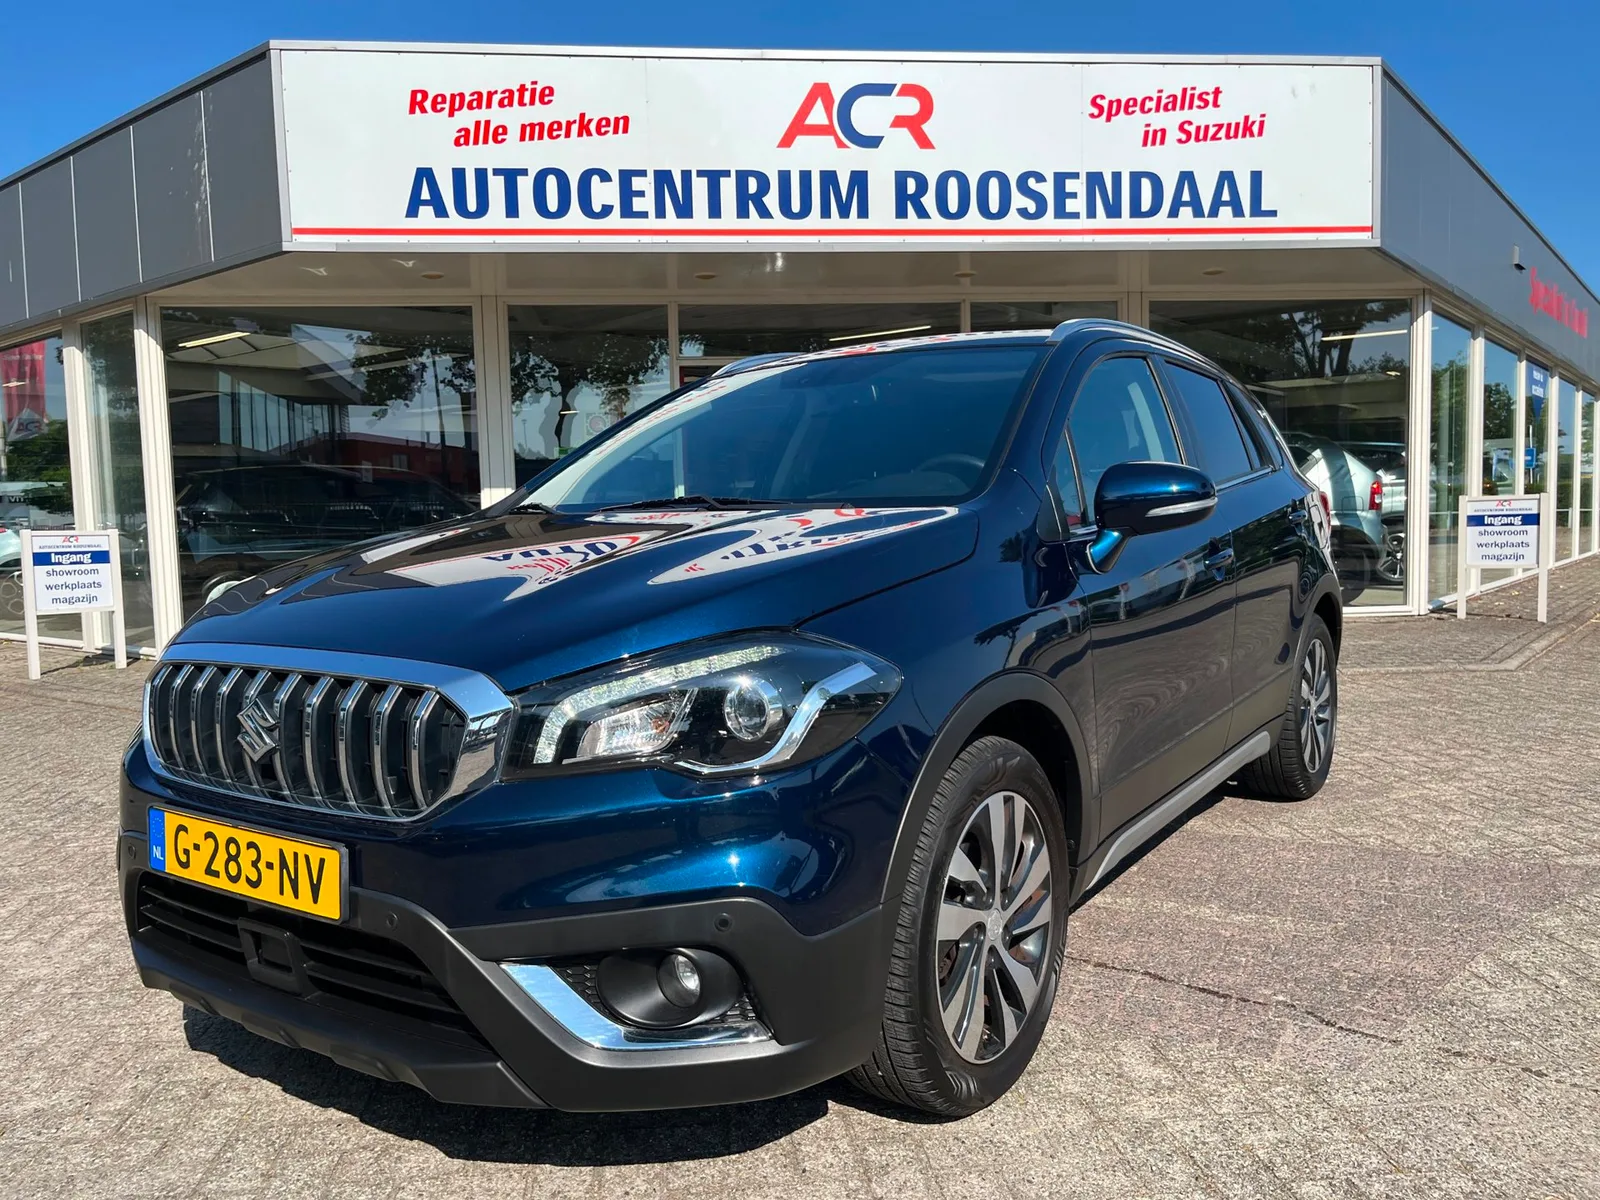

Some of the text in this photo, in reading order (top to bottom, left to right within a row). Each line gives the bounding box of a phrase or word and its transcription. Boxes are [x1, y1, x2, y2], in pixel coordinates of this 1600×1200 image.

[408, 80, 555, 118] Reparatie
[1088, 86, 1222, 123] Specialist
[776, 82, 936, 150] ACR
[453, 112, 630, 147] alle merken
[1142, 113, 1267, 147] in Suzuki
[404, 166, 1278, 221] AUTOCENTRUM ROOSENDAAL
[1484, 515, 1522, 526] Ingang
[1478, 528, 1528, 537] showroom
[1476, 540, 1530, 550] werkplaats
[50, 552, 92, 565] Ingang
[1481, 552, 1525, 562] magazijn
[45, 567, 99, 578] showroom
[44, 580, 102, 592] werkplaats
[51, 593, 98, 606] magazijn
[152, 844, 165, 862] NL
[173, 823, 326, 905] G-283-NV
